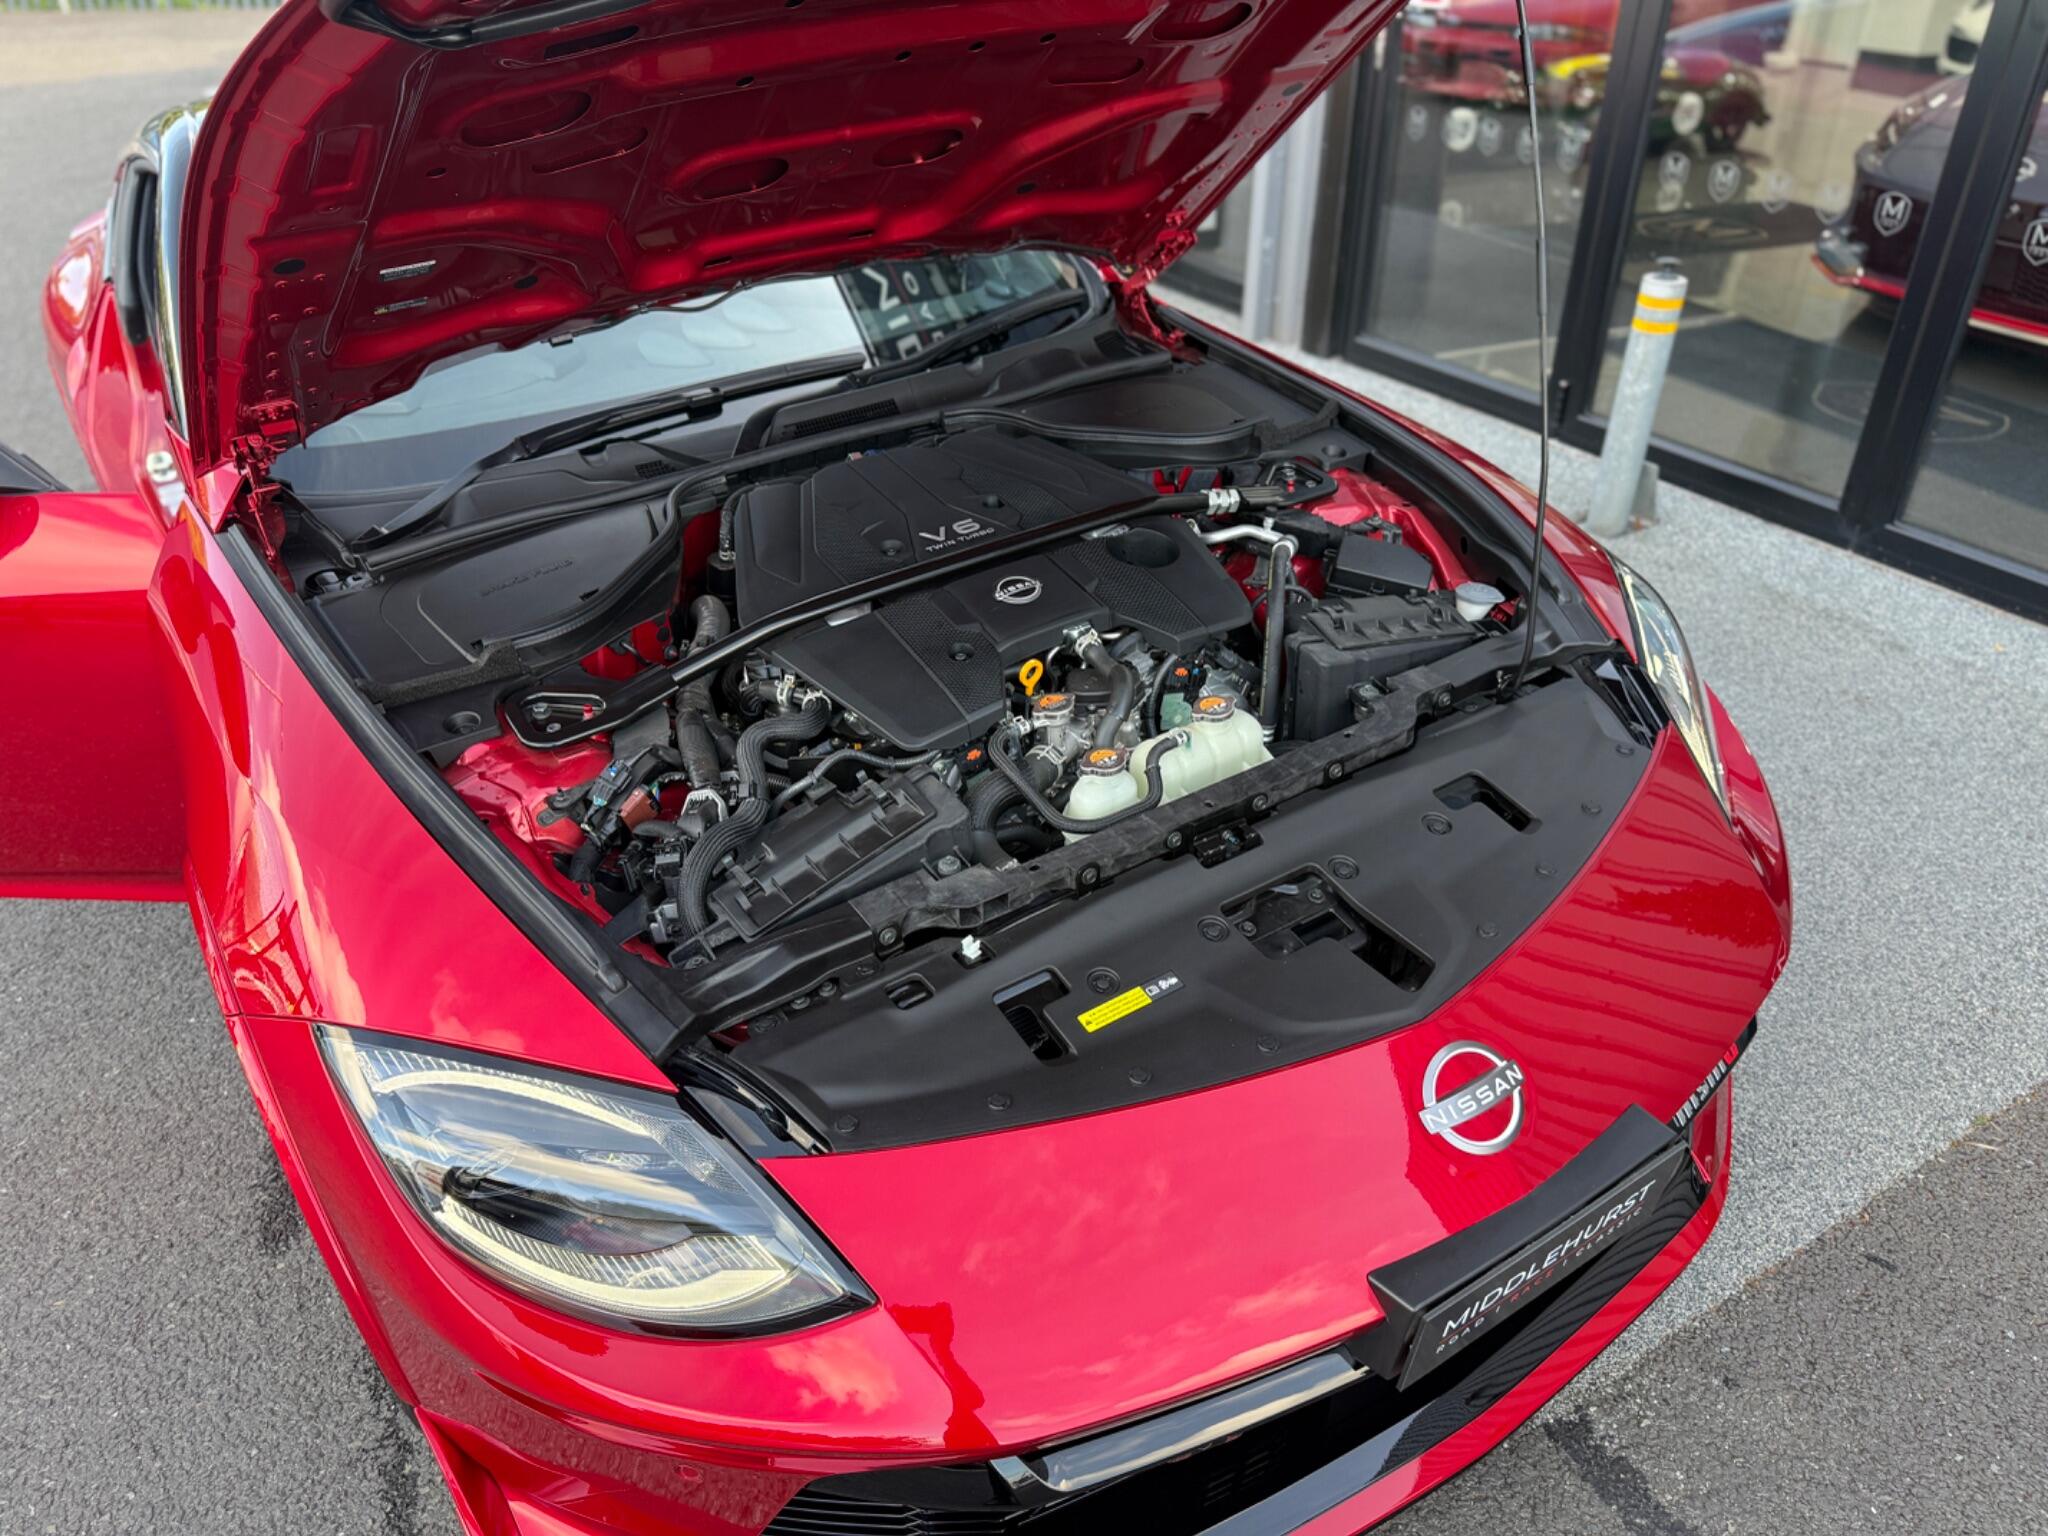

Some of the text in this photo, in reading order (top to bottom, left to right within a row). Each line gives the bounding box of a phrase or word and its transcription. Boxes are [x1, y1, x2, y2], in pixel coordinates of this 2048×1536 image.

[925, 527, 995, 553] TWIN TURBO
[1424, 1064, 1524, 1130] NISSAN
[1435, 1316, 1485, 1355] ROAD
[1510, 1268, 1554, 1303] RACE
[1575, 1206, 1643, 1258] CLASSIC
[1441, 1179, 1657, 1338] MIDDLEHURST
